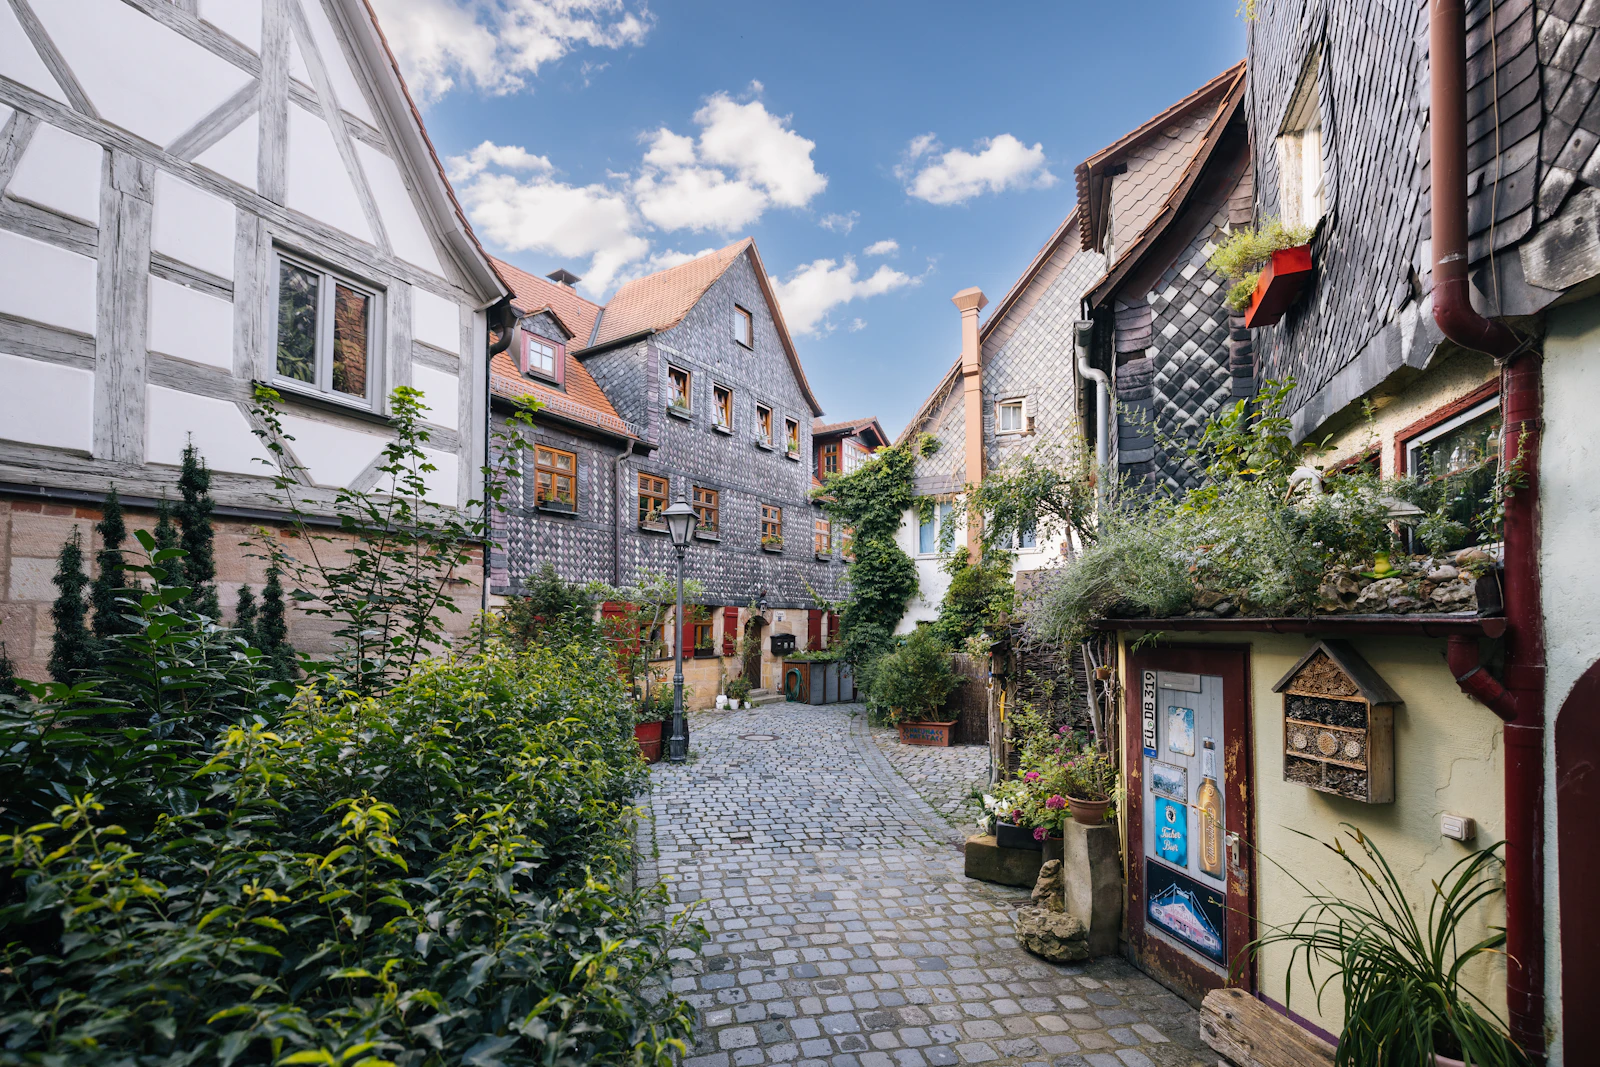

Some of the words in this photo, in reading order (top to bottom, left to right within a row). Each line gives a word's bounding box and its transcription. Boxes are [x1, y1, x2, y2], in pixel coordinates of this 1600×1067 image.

[1144, 672, 1155, 699] 319
[1144, 702, 1154, 720] DB
[1144, 729, 1155, 749] FÜ
[1160, 826, 1182, 839] Tucher
[1162, 840, 1179, 852] Bier
